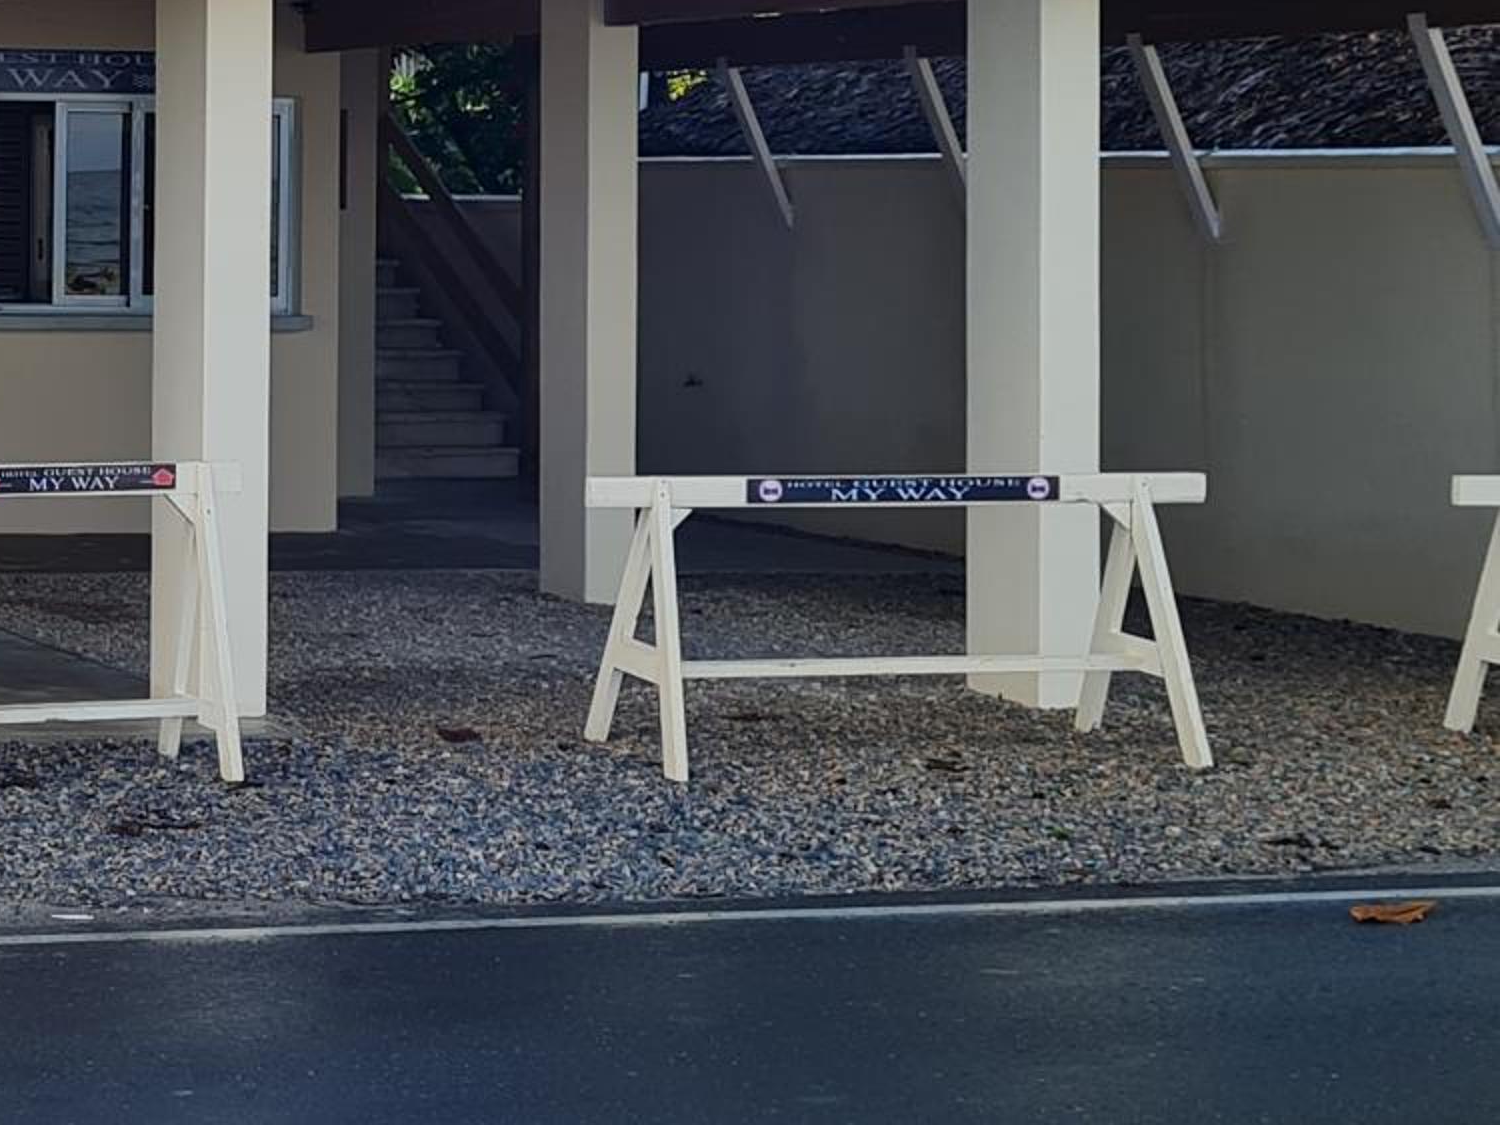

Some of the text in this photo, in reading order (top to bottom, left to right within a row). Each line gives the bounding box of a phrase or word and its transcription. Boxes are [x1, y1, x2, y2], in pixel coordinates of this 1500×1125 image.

[77, 53, 155, 66] HOU
[6, 68, 124, 89] WAY
[43, 468, 93, 477] GUEST
[99, 466, 150, 476] HOUSE
[29, 476, 119, 492] MY WAY
[852, 479, 932, 488] GUEST
[940, 478, 1020, 488] HOUSE
[831, 487, 970, 501] MY WAY
